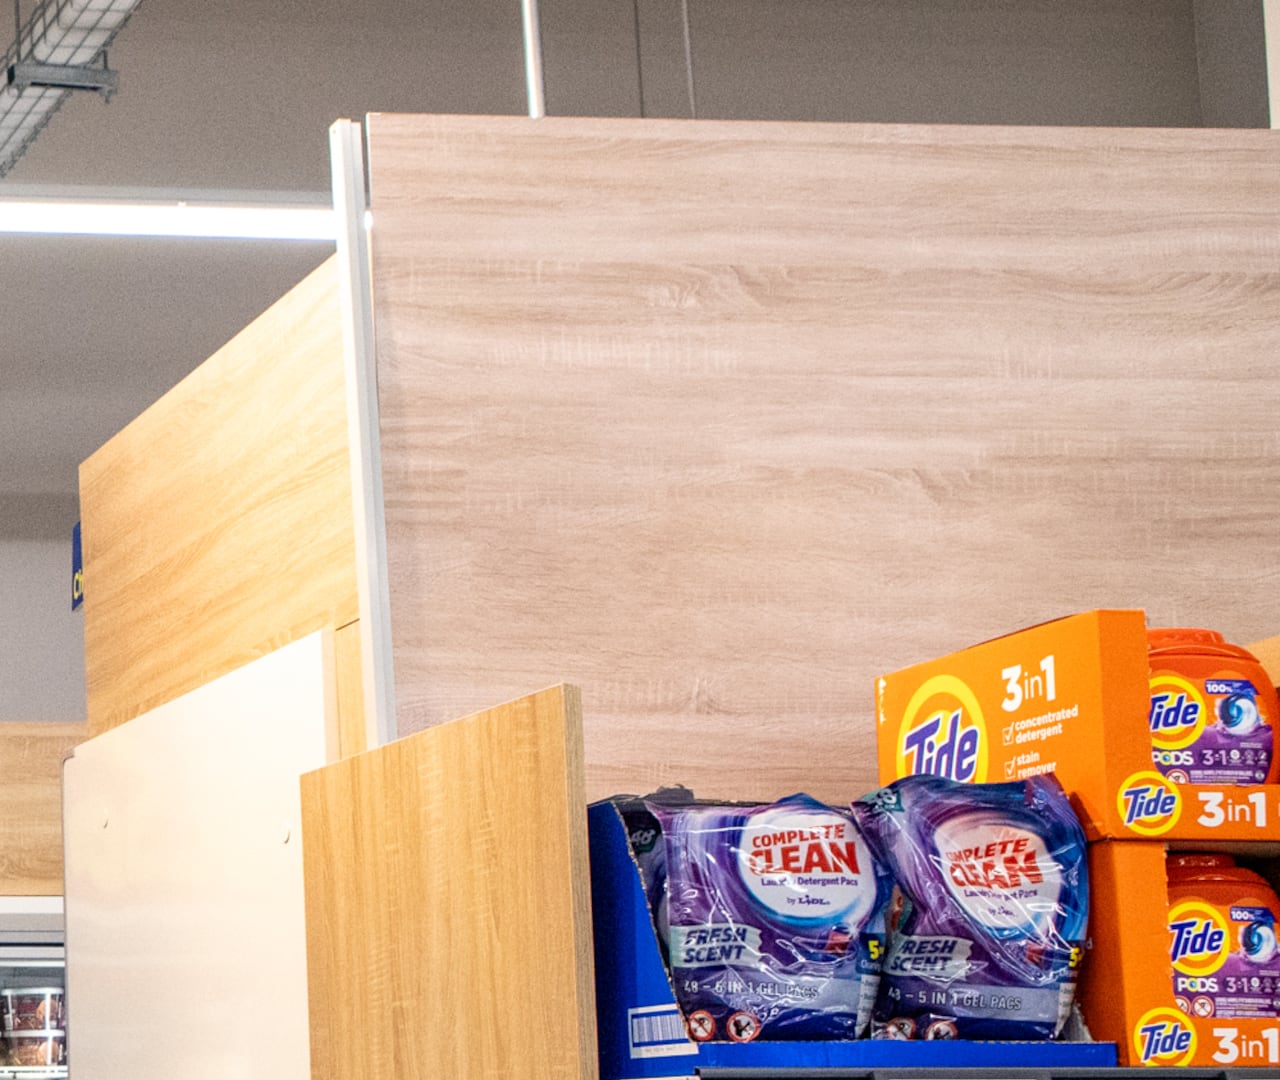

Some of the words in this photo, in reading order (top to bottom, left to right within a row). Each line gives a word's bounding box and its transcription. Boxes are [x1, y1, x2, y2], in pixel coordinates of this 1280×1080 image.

[1014, 705, 1079, 734] concentrated
[1149, 693, 1199, 730] Tide
[903, 709, 979, 783] Tide
[1014, 723, 1063, 746] detergent
[1015, 751, 1041, 766] stain
[1015, 759, 1056, 778] remover
[1153, 751, 1194, 766] PODS
[1124, 787, 1176, 825] Tide
[1197, 791, 1267, 827] 3in1
[752, 824, 846, 847] COMPLETE
[749, 842, 861, 875] CLEAN
[949, 851, 1044, 889] CLEAN
[840, 877, 858, 887] Pacs
[685, 927, 748, 946] FRESH
[1169, 920, 1224, 963] Tide
[683, 945, 746, 963] SCENT
[1177, 977, 1218, 992] PODS
[932, 991, 946, 1003] IN
[963, 995, 986, 1007] GEL
[991, 996, 1022, 1010] PACS
[1140, 1022, 1192, 1062] Tide
[1212, 1028, 1280, 1064] 3in1
